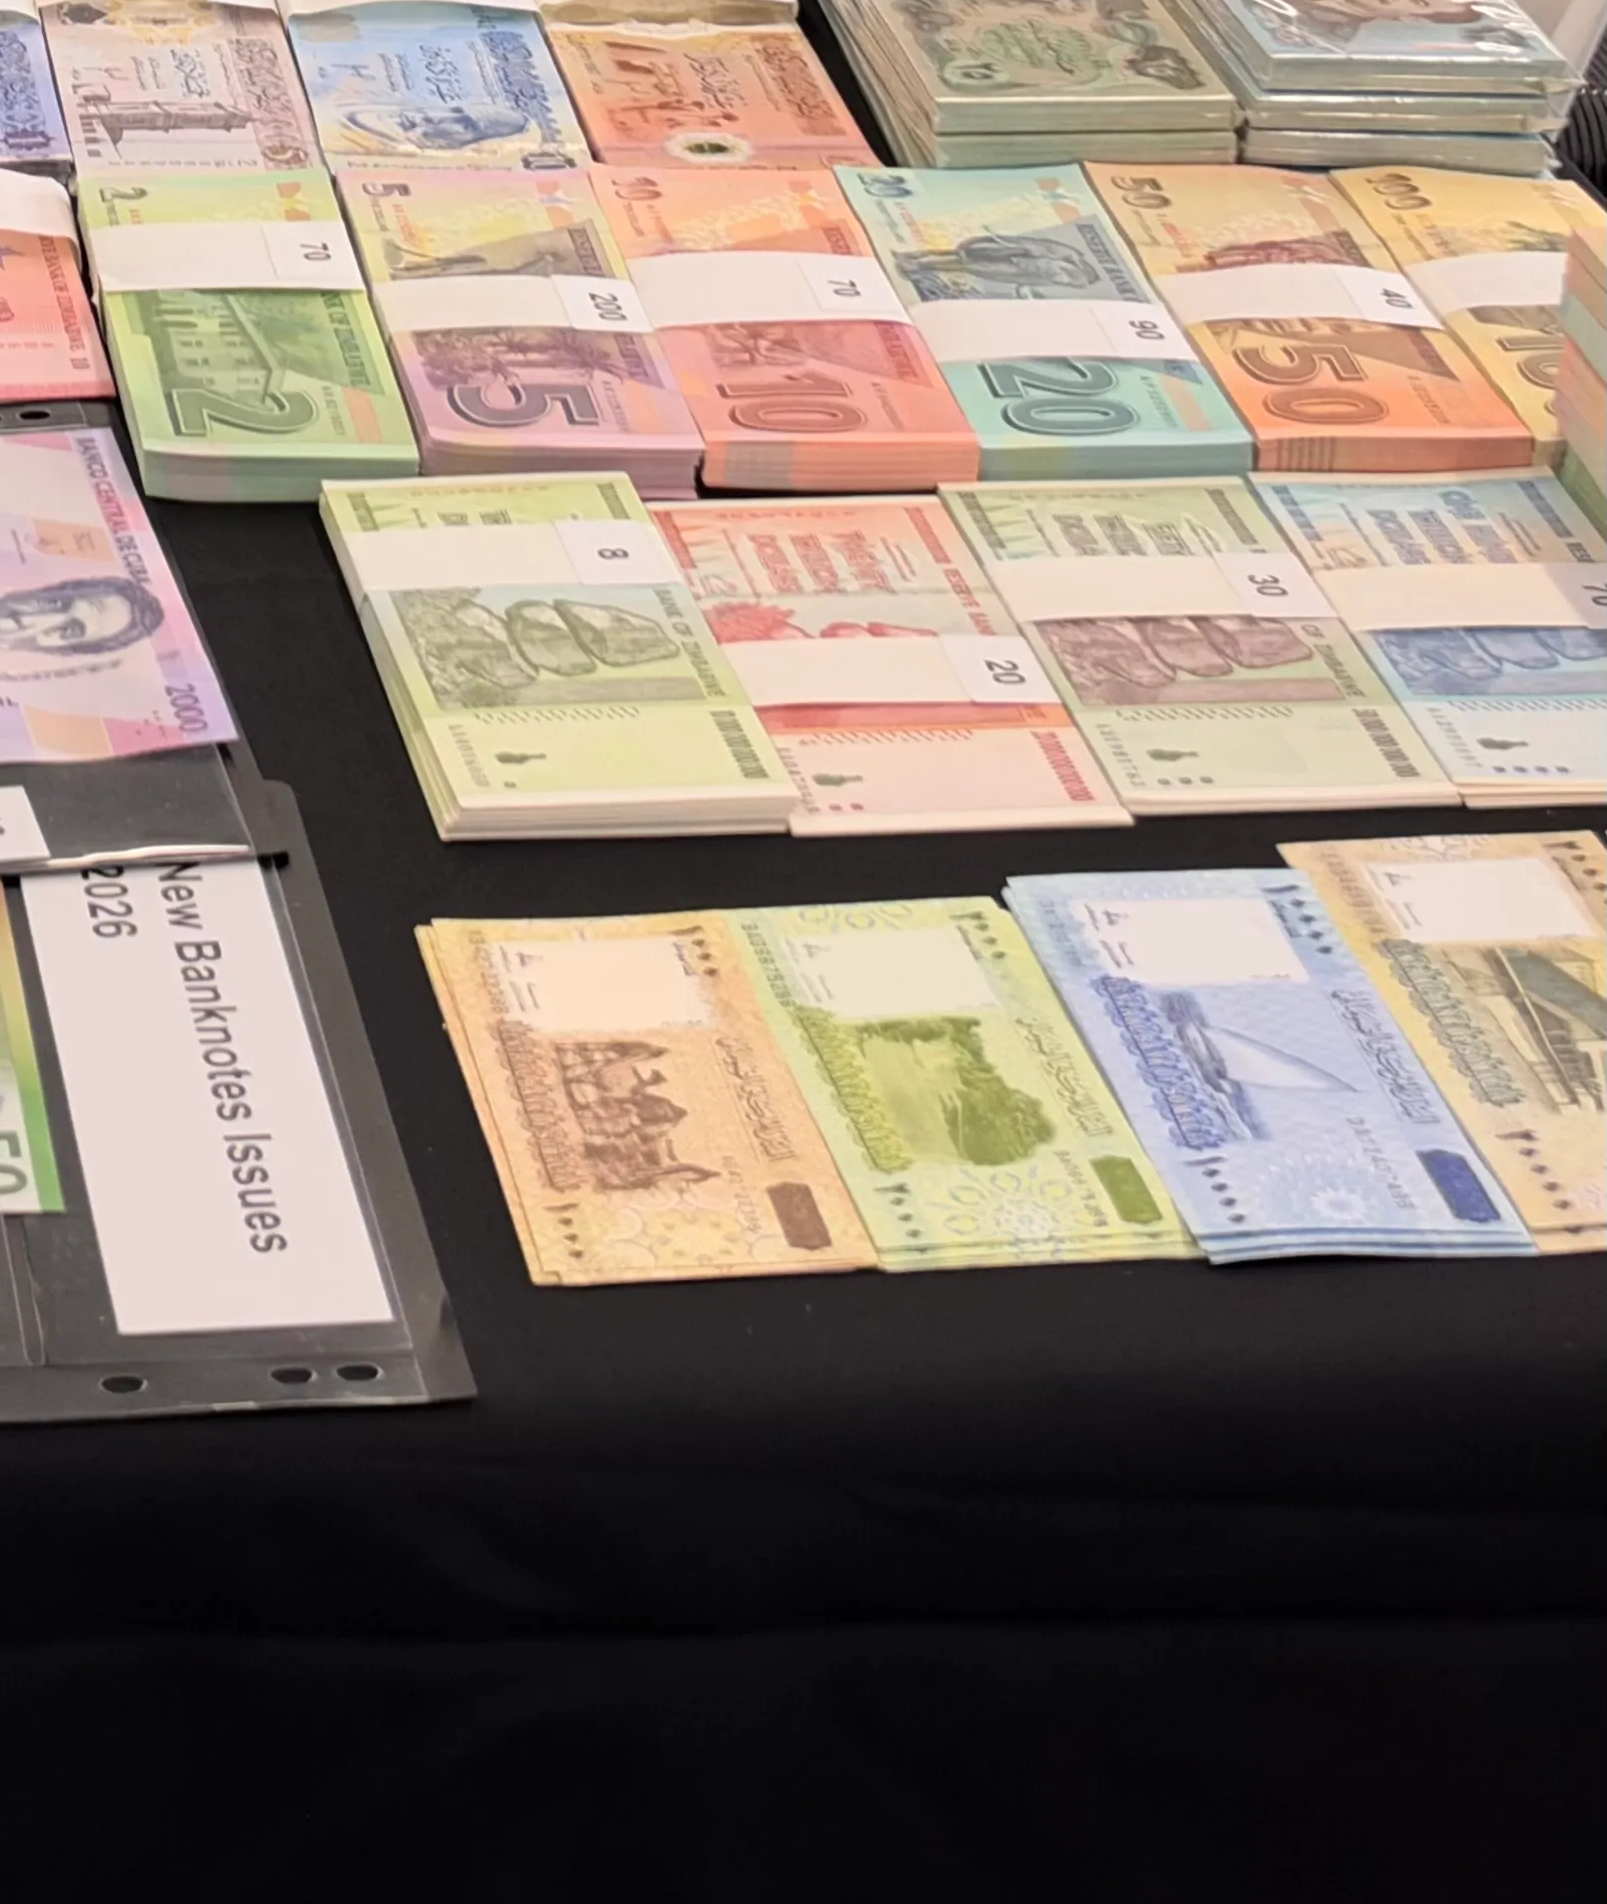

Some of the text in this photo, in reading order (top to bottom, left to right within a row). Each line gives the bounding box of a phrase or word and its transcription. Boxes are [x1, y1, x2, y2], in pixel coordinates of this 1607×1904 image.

[361, 180, 413, 199] 5
[1110, 175, 1164, 210] 50
[301, 243, 331, 260] 70
[589, 293, 627, 320] 200
[829, 280, 861, 297] 70
[1382, 283, 1418, 308] 40
[1129, 321, 1165, 340] 90
[444, 380, 604, 428] 5
[715, 372, 868, 434] 10
[976, 360, 1141, 438] 20
[1233, 339, 1391, 424] 50
[170, 388, 321, 437] 2
[74, 437, 109, 479] BANCO
[93, 480, 127, 534] CENTRAL
[115, 535, 139, 550] DE
[598, 549, 629, 559] 8
[1248, 575, 1288, 596] 30
[654, 587, 680, 618] BANK
[683, 641, 725, 698] ZIMBABWE
[985, 661, 1025, 684] 20
[1318, 652, 1365, 708] ZIMBABWE
[163, 683, 210, 733] 2000
[80, 867, 138, 939] 2026
[159, 861, 288, 1254] New Banknotes Issues
